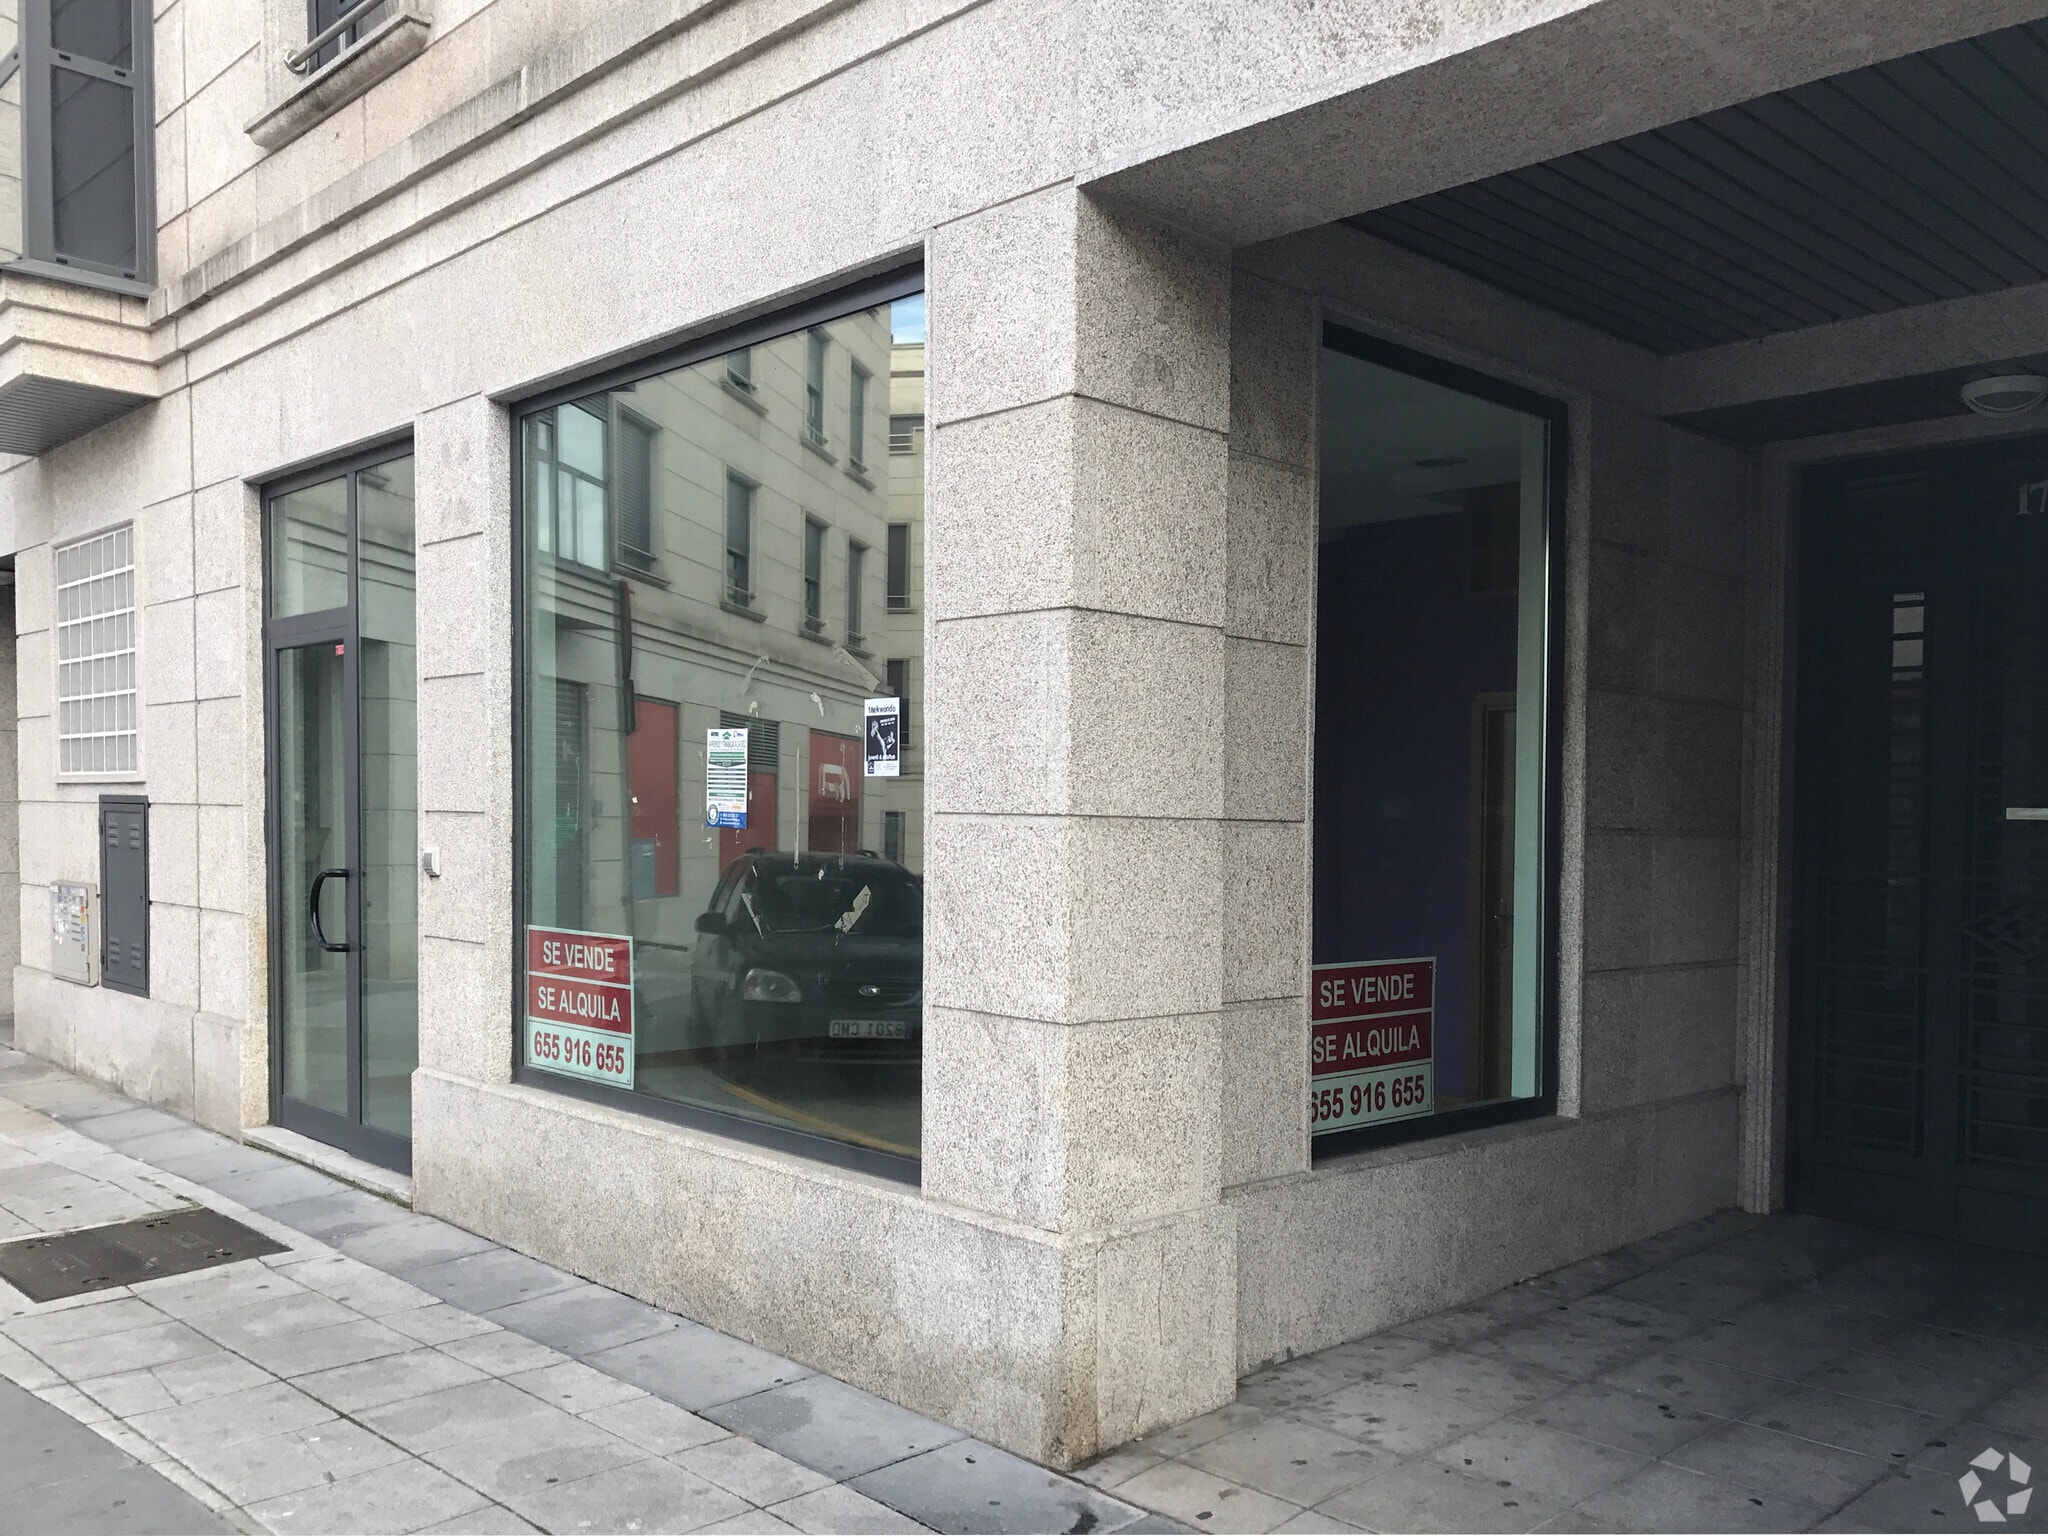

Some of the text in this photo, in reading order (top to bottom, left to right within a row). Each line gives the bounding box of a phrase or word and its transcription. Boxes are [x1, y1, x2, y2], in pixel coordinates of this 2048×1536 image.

[868, 704, 896, 714] taekwondo
[543, 940, 615, 973] SE VENDE
[538, 986, 621, 1022] SE ALQUILA
[1320, 973, 1415, 1008] SE VENDE
[534, 1030, 625, 1074] 655 916 655
[1313, 1024, 1420, 1064] SE ALQUILA
[1350, 1080, 1386, 1116] 916
[1392, 1074, 1425, 1109] 655
